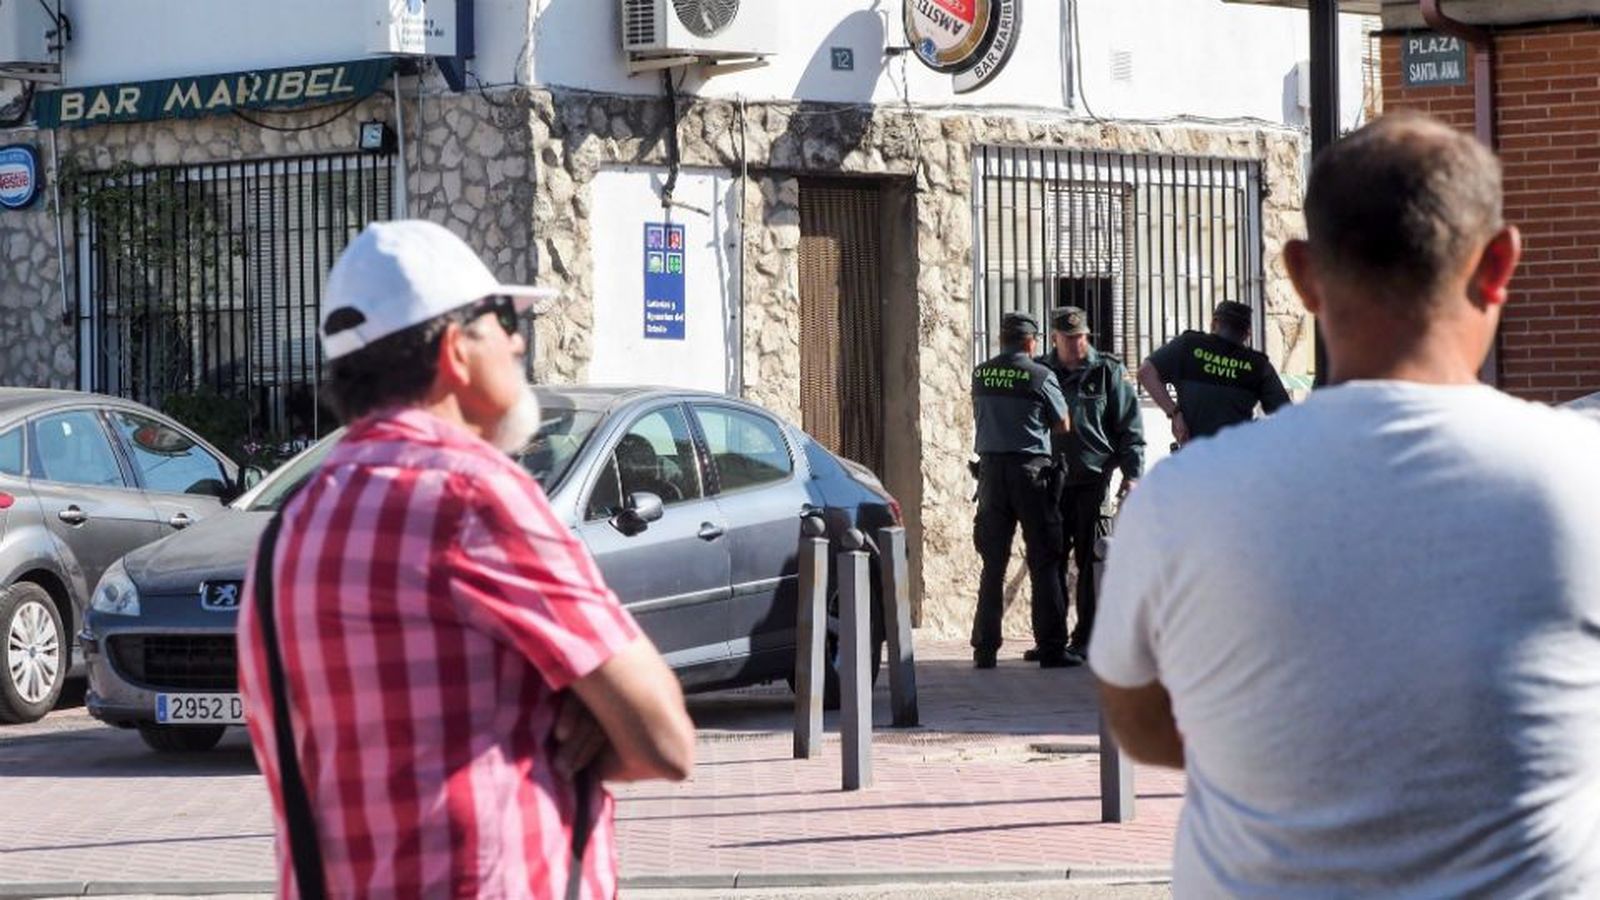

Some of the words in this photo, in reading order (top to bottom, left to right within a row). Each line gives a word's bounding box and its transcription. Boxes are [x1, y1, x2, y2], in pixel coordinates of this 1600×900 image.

[1409, 36, 1460, 54] PLAZA
[834, 51, 849, 68] 12
[973, 52, 998, 79] BAR
[1409, 62, 1439, 82] SANTA
[1440, 60, 1460, 79] ANA
[60, 87, 141, 121] BAR
[163, 66, 355, 112] MARIBEL
[1193, 348, 1252, 371] GUARDIA
[1203, 363, 1238, 379] CIVIL
[984, 377, 1014, 388] CIVIL
[172, 698, 223, 719] 2952
